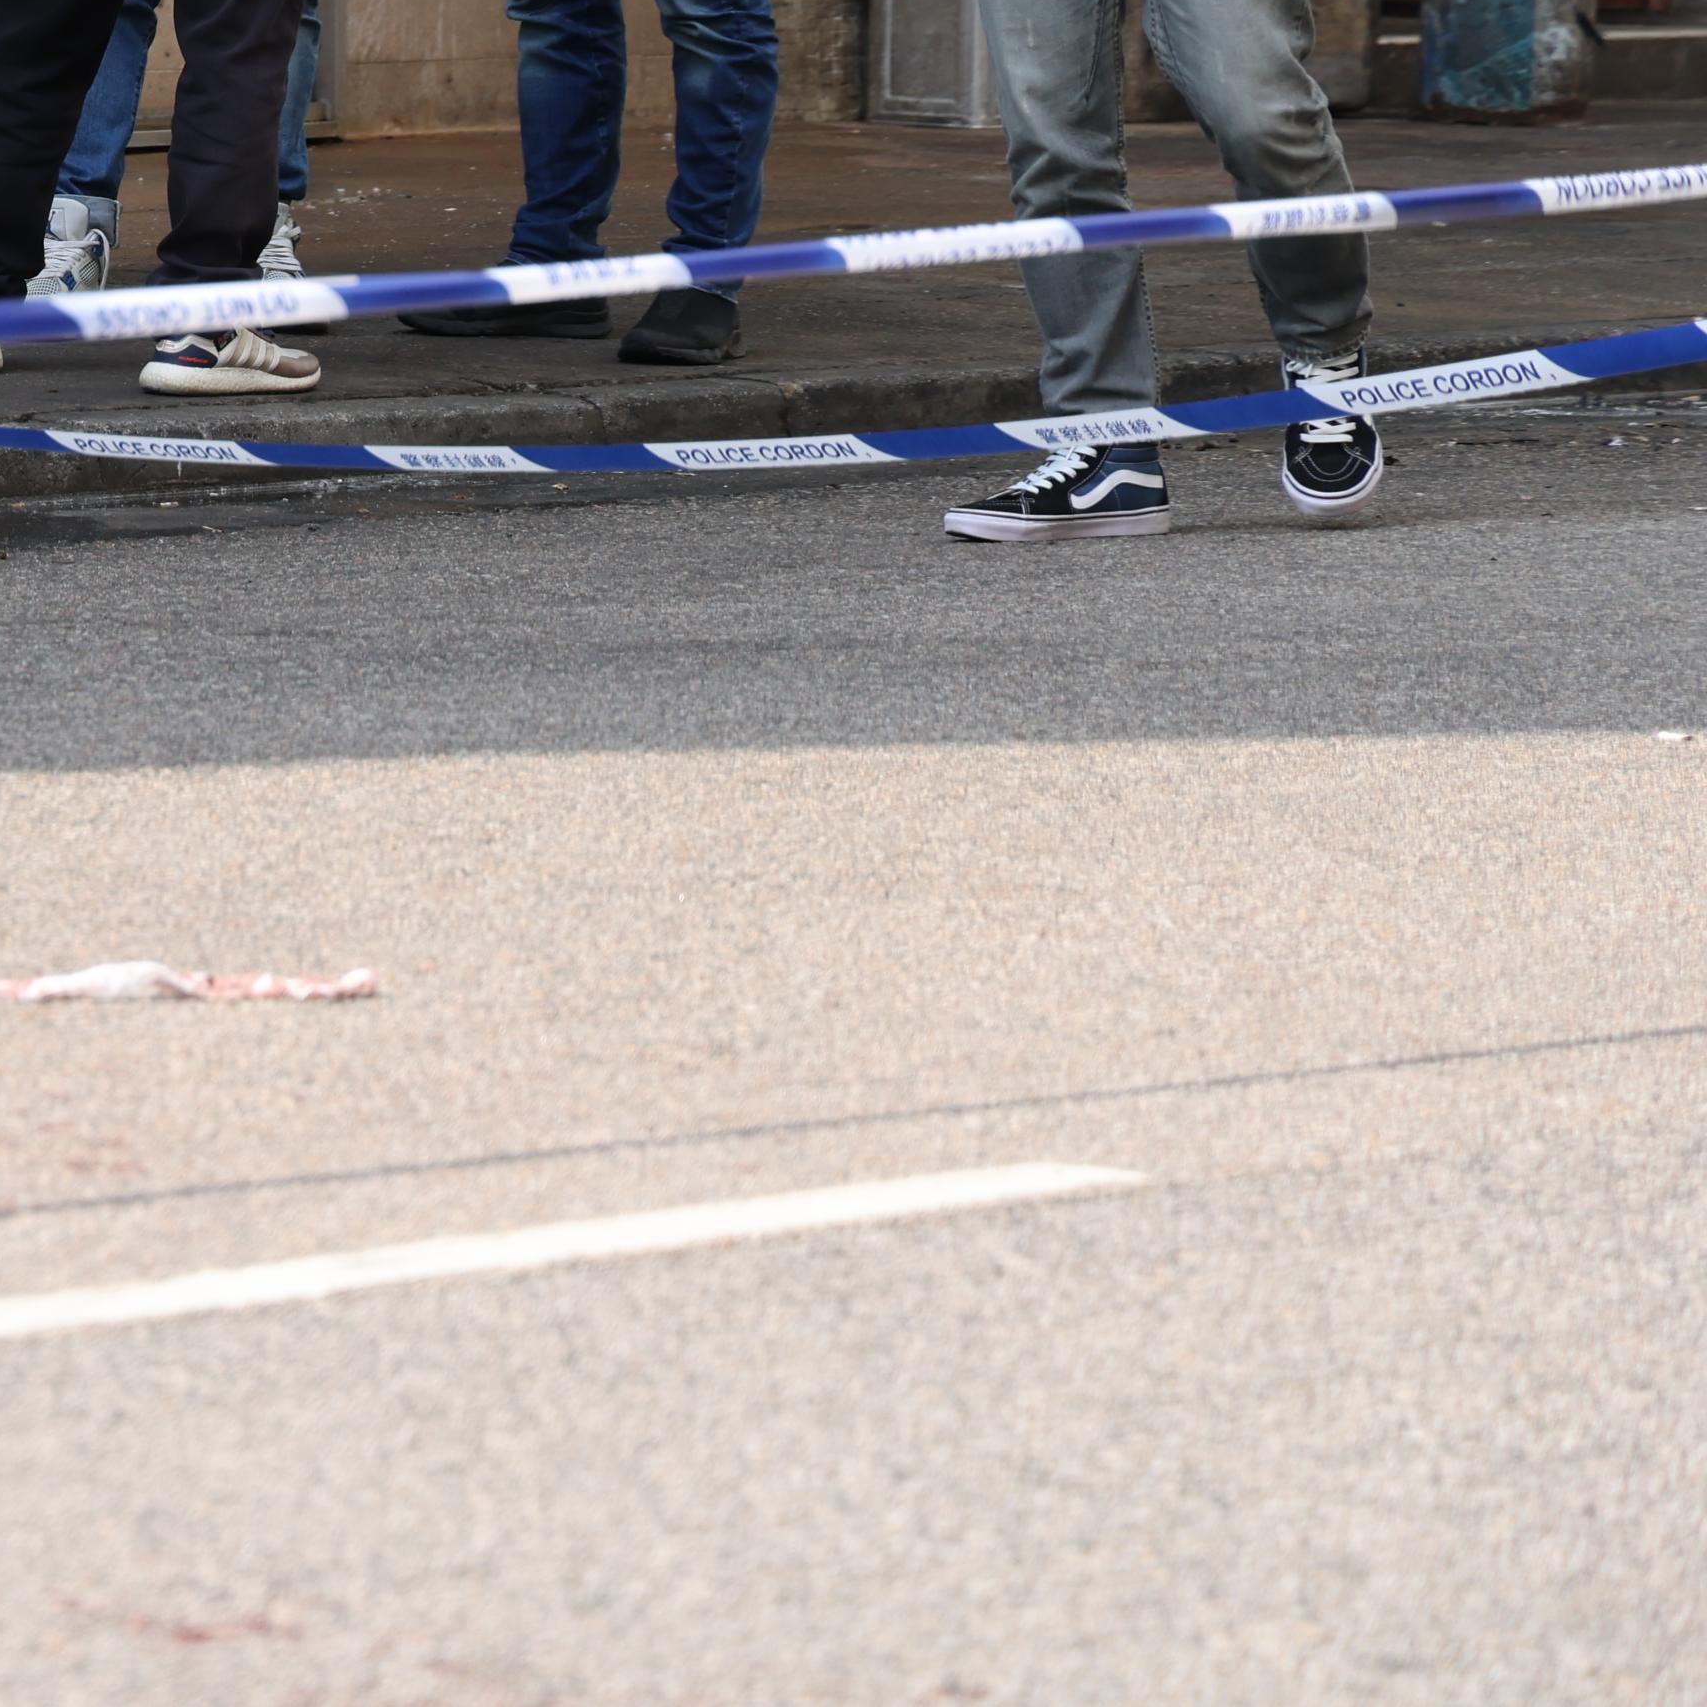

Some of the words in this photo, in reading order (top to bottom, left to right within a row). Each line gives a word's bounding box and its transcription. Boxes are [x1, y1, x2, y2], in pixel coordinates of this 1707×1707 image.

[1341, 378, 1434, 408] POLICE
[73, 437, 148, 457] POLICE
[675, 446, 760, 465] POLICE
